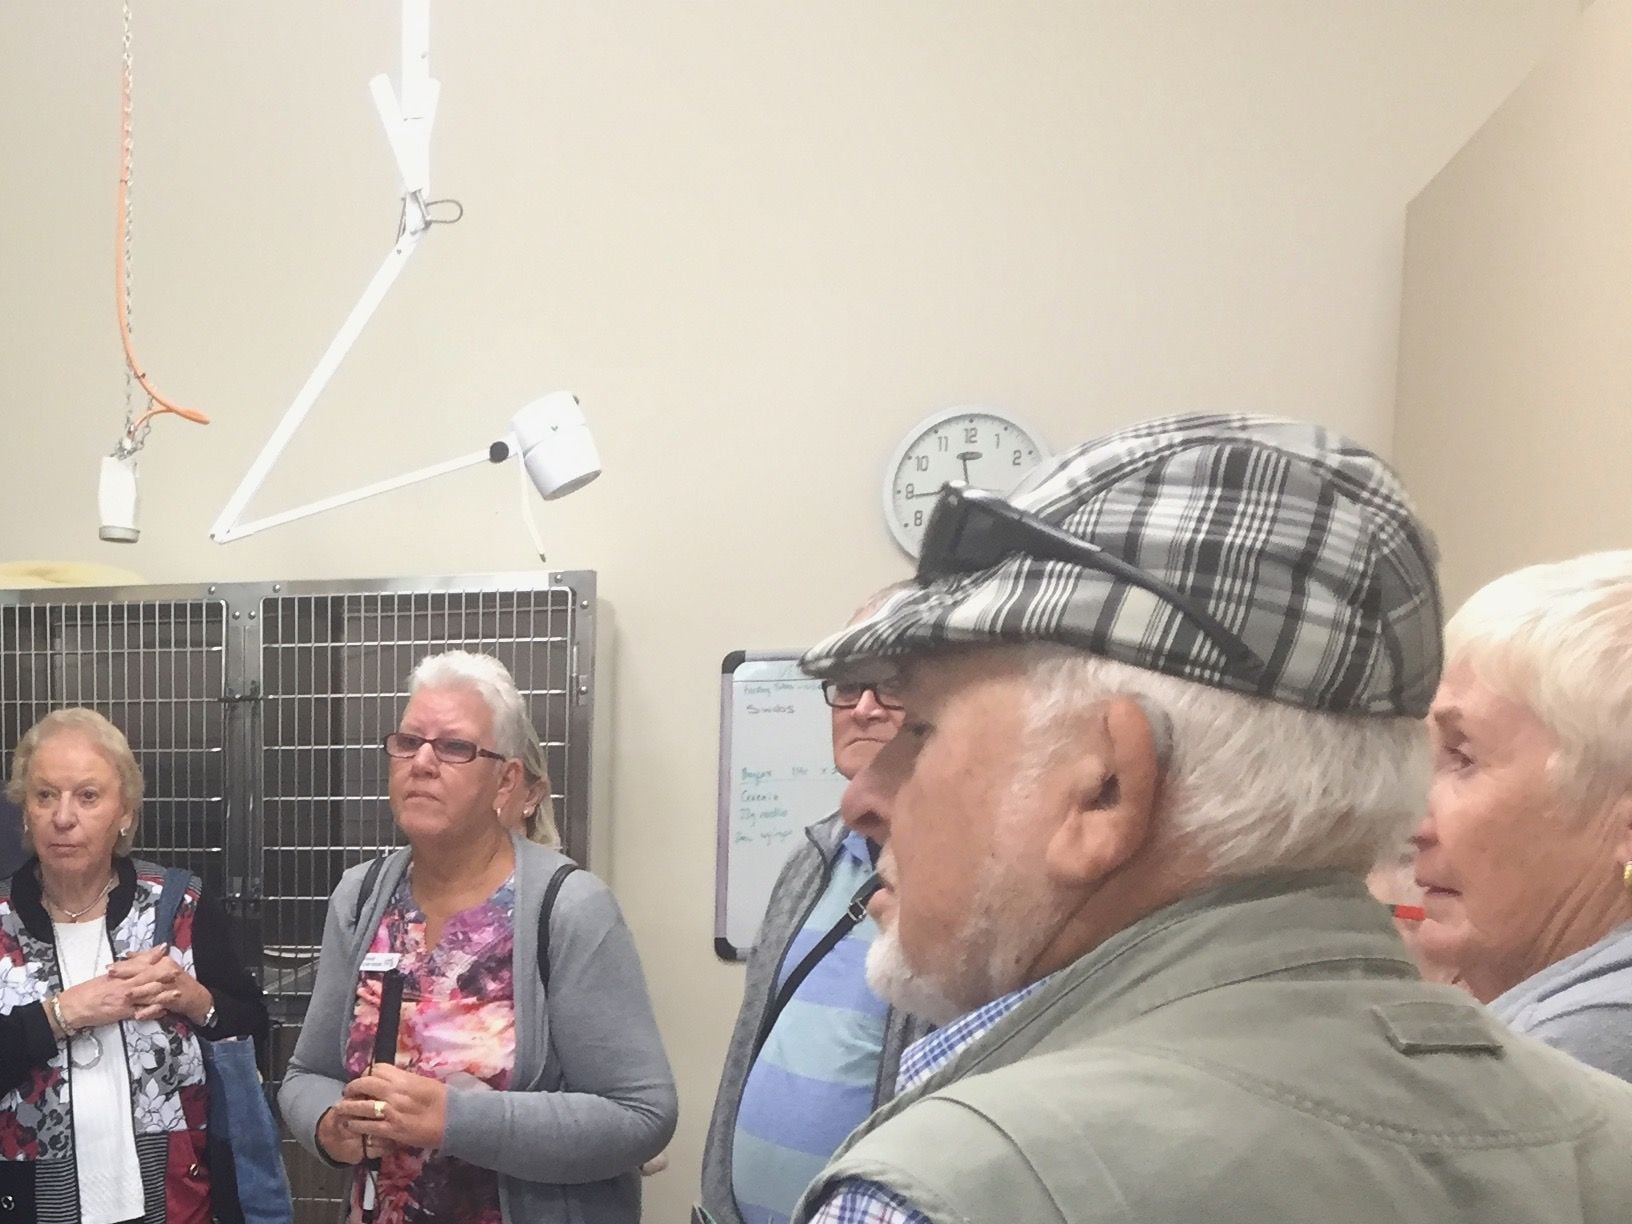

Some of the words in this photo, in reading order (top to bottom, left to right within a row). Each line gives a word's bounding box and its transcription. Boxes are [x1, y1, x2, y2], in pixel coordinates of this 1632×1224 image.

[938, 436, 949, 451] 11
[964, 428, 978, 444] 12
[995, 433, 1001, 449] 1
[916, 456, 929, 472] 10
[1012, 450, 1022, 466] 2
[914, 510, 923, 527] 8
